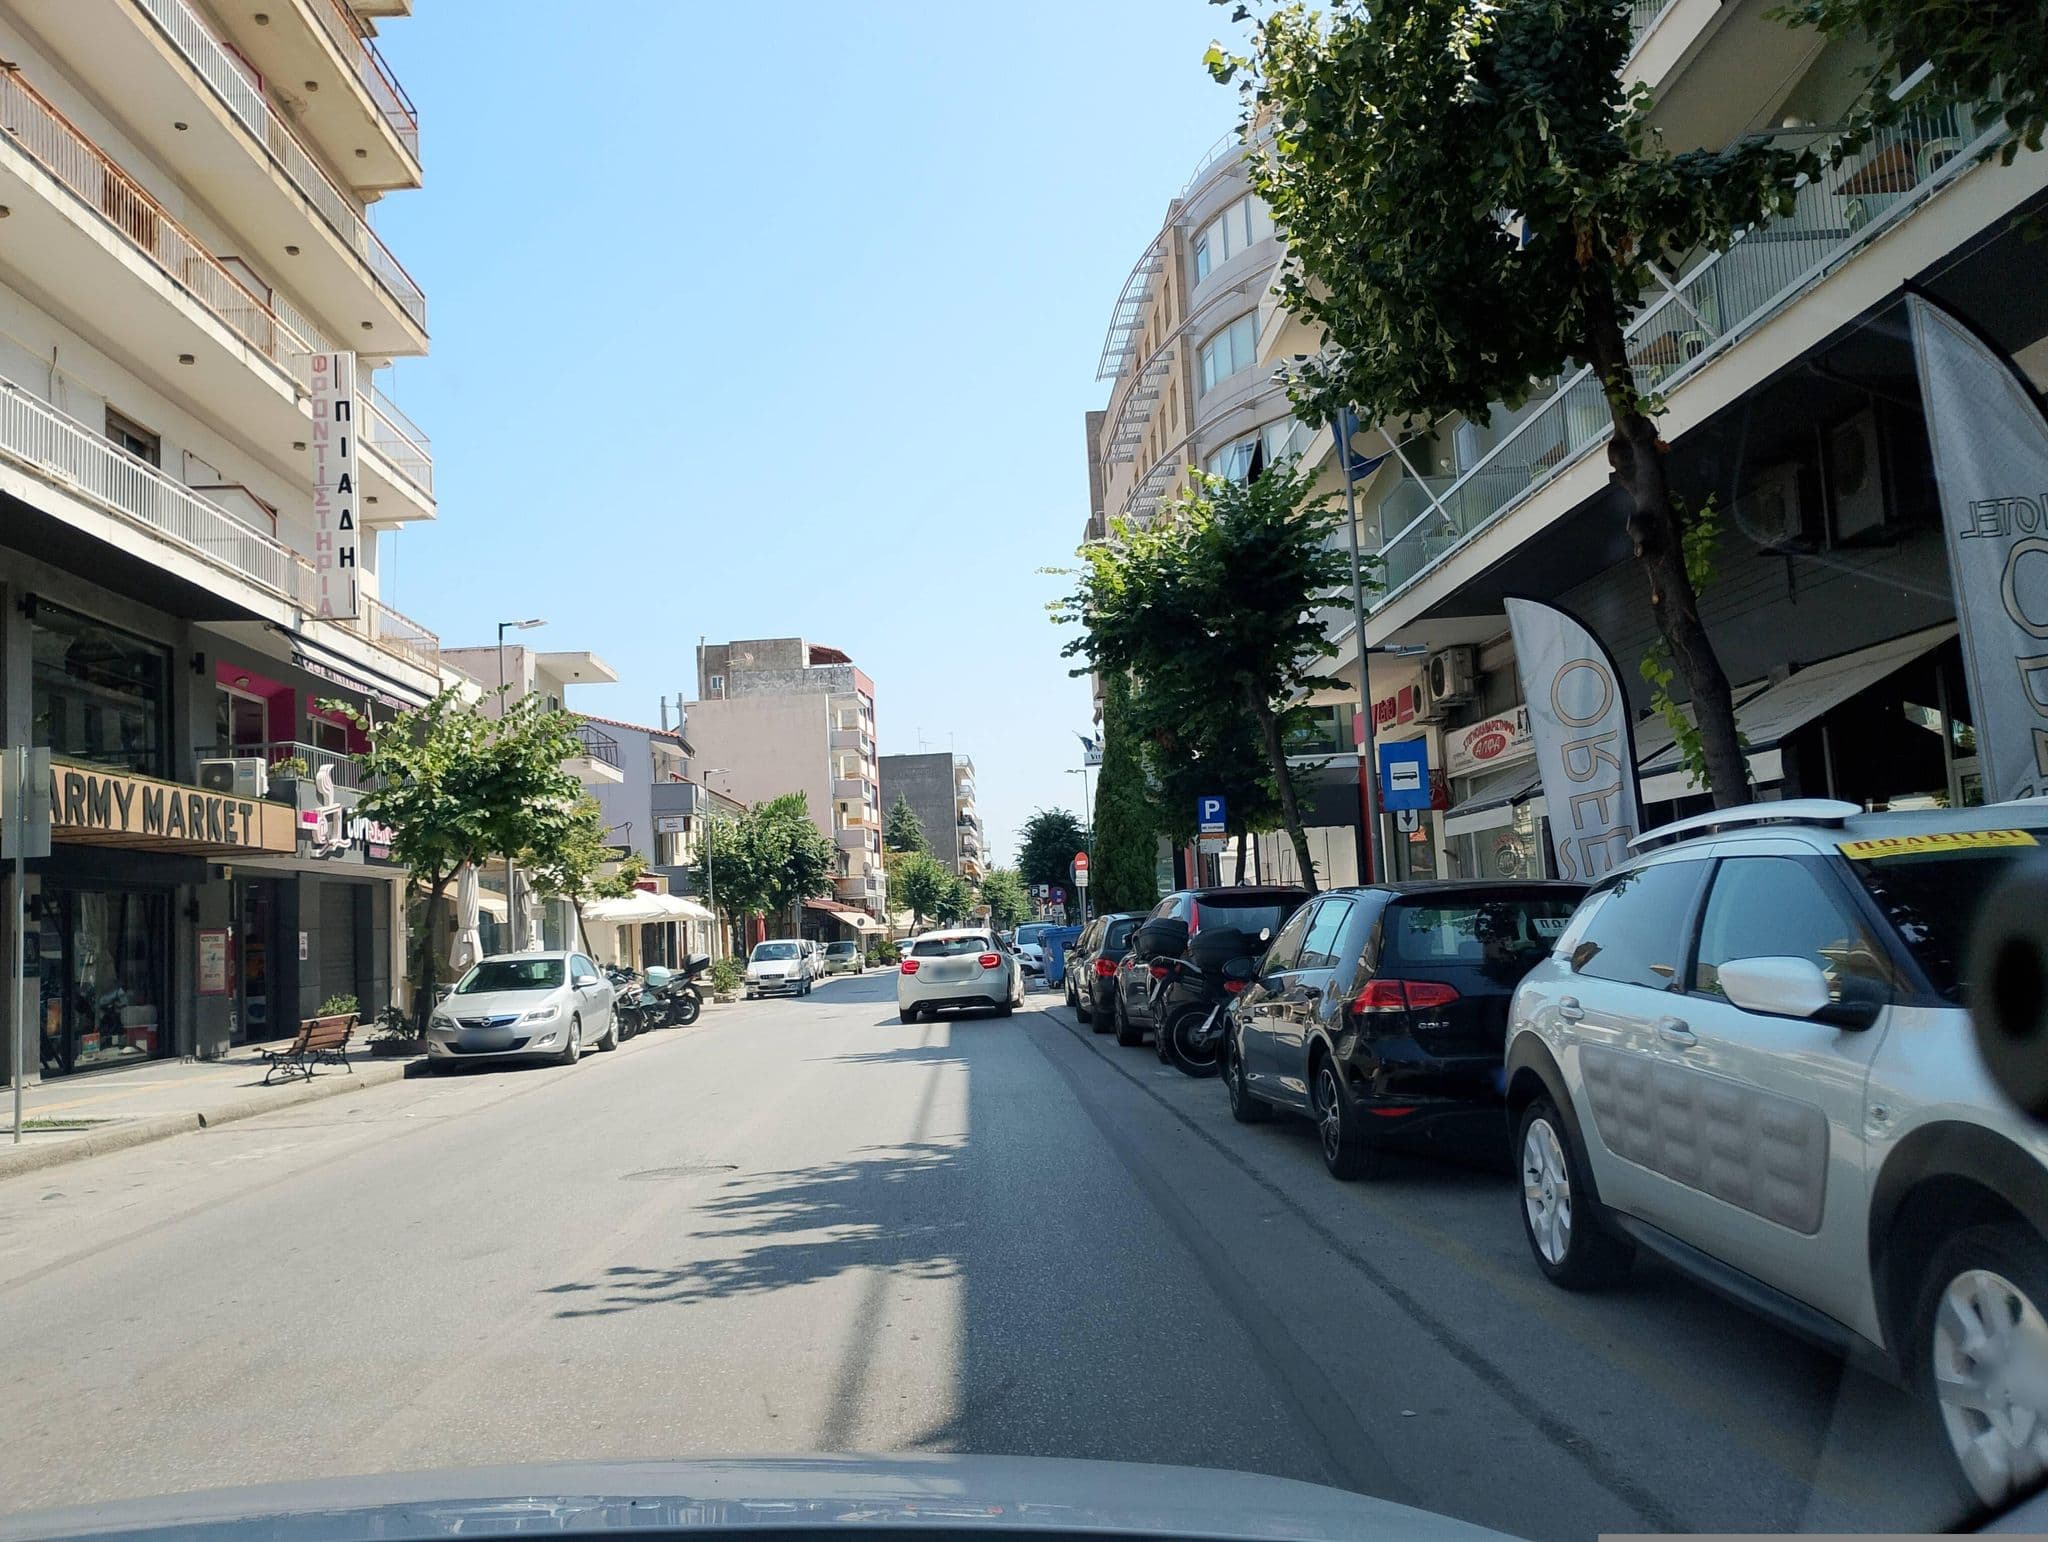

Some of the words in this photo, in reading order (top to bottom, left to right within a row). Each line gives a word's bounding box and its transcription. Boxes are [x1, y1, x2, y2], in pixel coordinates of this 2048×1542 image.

[335, 399, 355, 569] ΠΙΑΔΗ
[50, 767, 135, 830] ARMY
[142, 785, 253, 845] MARKET
[1204, 800, 1220, 820] P
[1853, 830, 2022, 851] ΠΩΛΕΙΤΑΙ
[1032, 888, 1038, 896] P
[1418, 1021, 1450, 1030] GOLF
